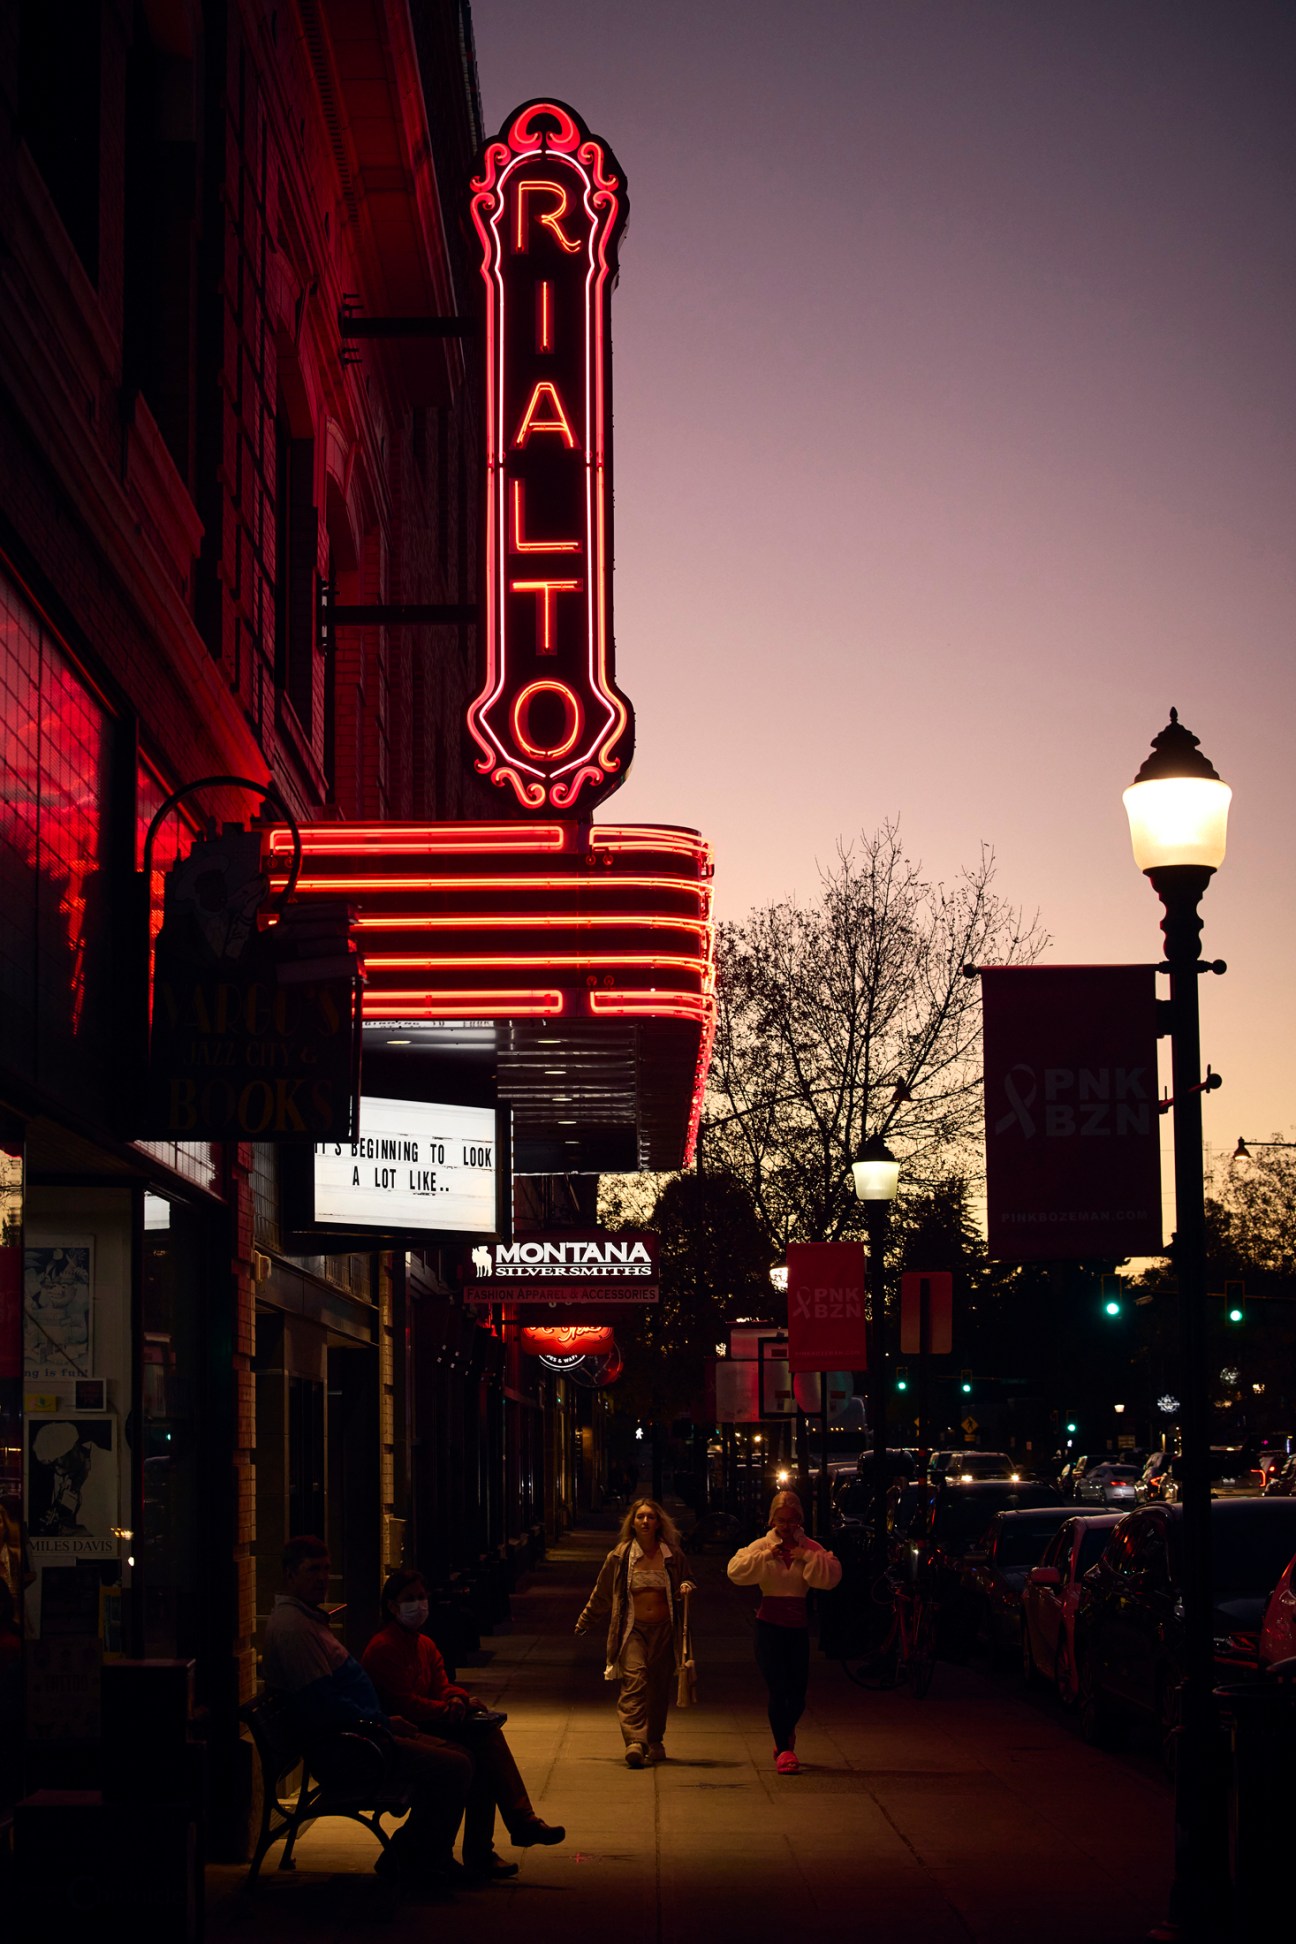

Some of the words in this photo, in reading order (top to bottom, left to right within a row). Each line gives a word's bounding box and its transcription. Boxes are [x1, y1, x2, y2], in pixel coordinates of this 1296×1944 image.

[509, 180, 584, 760] RIALTO
[184, 1041, 236, 1067] JAZZ
[244, 1040, 294, 1067] CITY
[1044, 1067, 1149, 1100] PNK
[166, 1077, 334, 1134] BOOKS
[1045, 1103, 1150, 1136] BZN
[351, 1138, 418, 1162] BEGINNING
[430, 1143, 444, 1164] TO
[463, 1146, 492, 1168] LOOK
[352, 1166, 360, 1186] A
[375, 1167, 396, 1189] LOT
[1001, 1209, 1148, 1223] PINKBOZEMAN.COM
[495, 1242, 652, 1263] MONTANA
[495, 1266, 652, 1276] SILVERSMITHS
[814, 1287, 861, 1301] PNK
[814, 1303, 862, 1319] BZN
[31, 1540, 70, 1551] MILES
[73, 1540, 113, 1551] DAVIS
